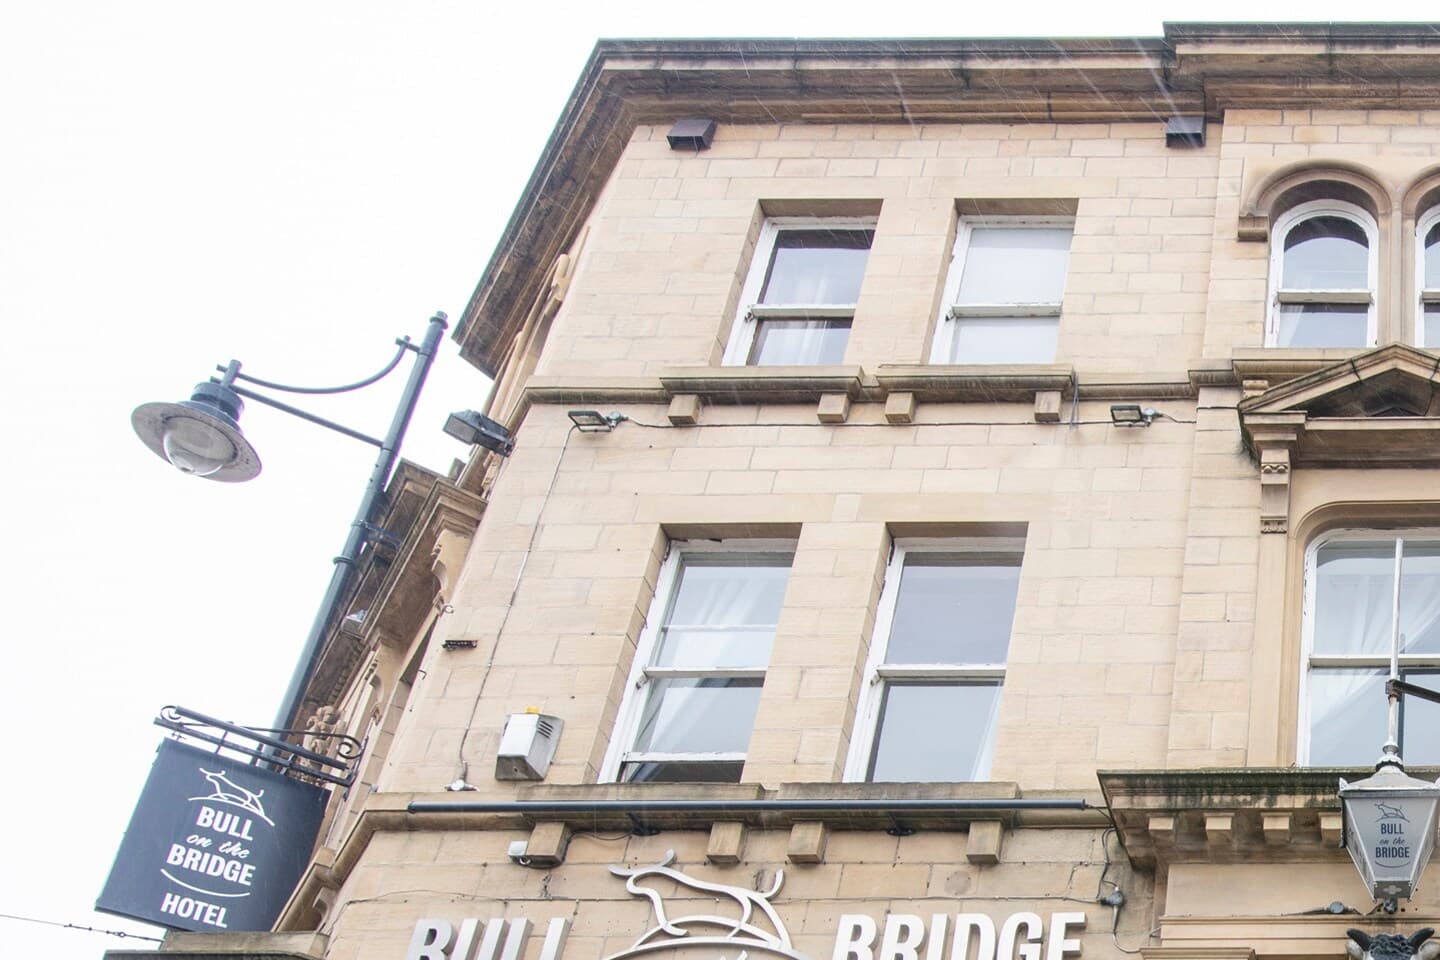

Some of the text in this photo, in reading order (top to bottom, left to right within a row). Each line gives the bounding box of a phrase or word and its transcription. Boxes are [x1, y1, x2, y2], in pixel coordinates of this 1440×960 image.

[196, 806, 253, 841] BULL
[1381, 823, 1404, 835] BULL
[186, 834, 250, 859] on the
[1375, 846, 1410, 858] BRIDGE
[166, 843, 256, 886] BRIDGE
[160, 892, 228, 928] HOTEL
